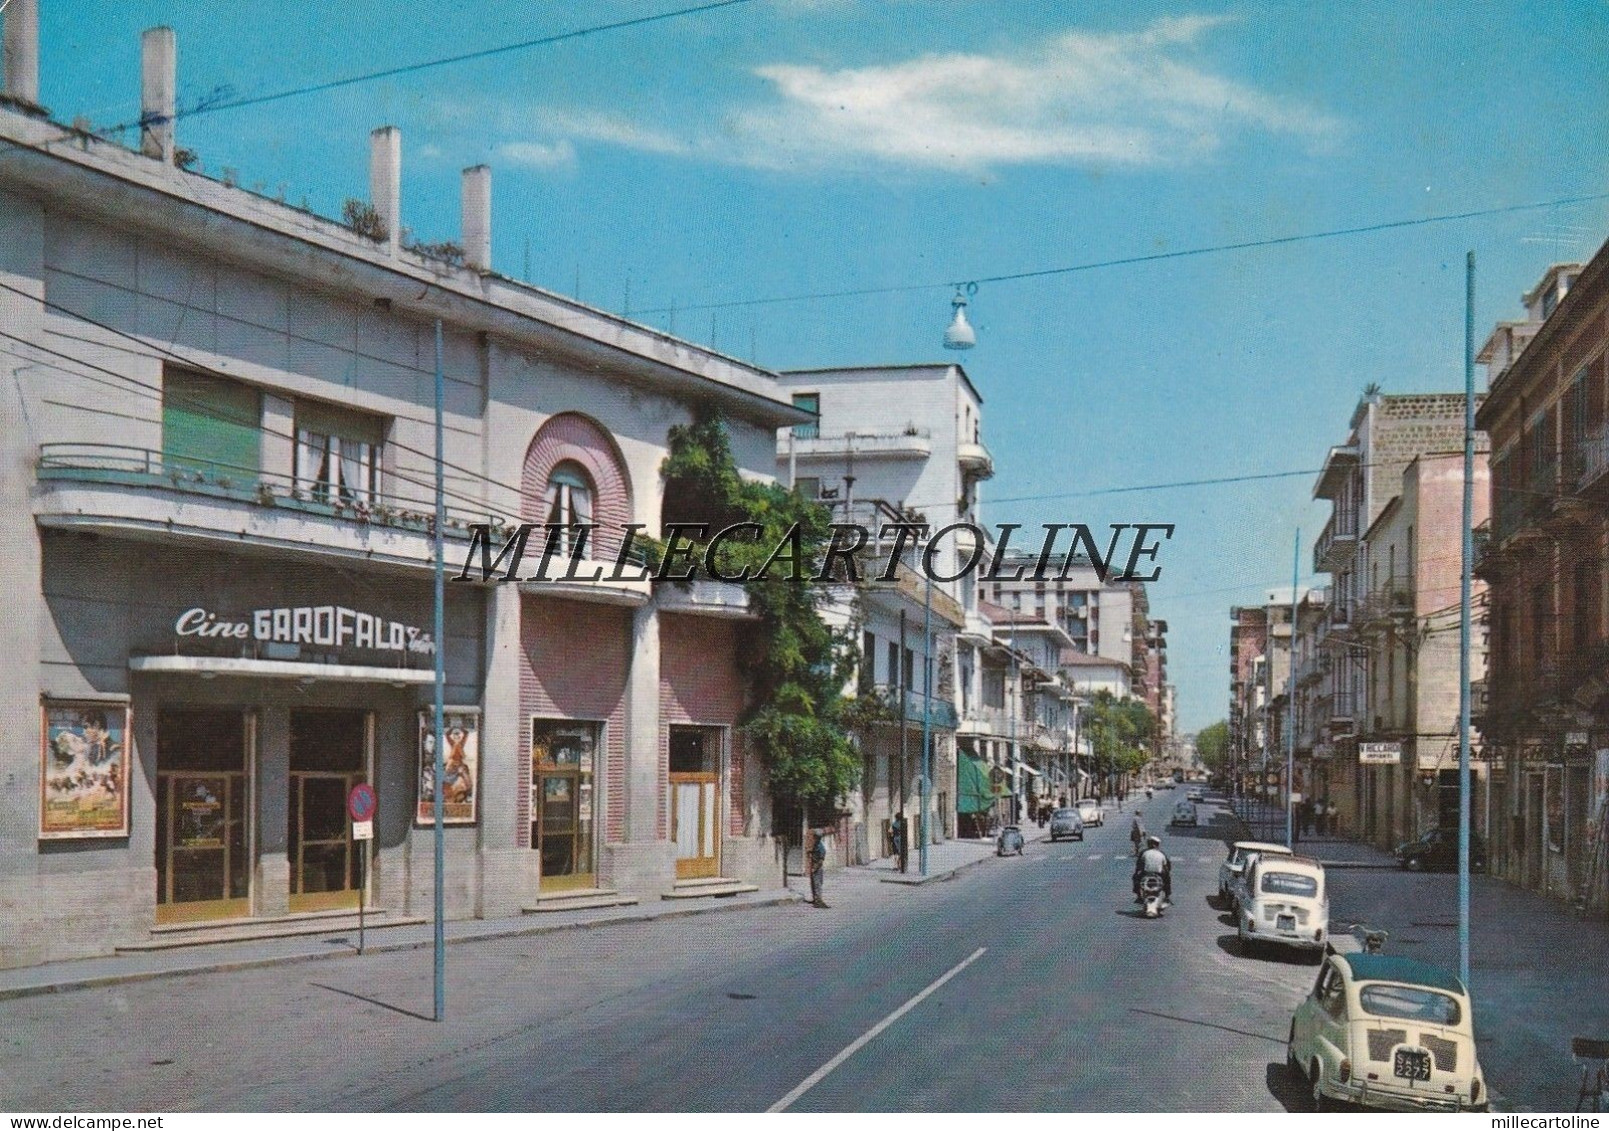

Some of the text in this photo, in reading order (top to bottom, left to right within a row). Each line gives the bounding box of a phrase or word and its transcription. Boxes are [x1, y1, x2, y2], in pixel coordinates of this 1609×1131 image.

[175, 607, 249, 639] Cine
[253, 605, 405, 651] GAROFALO
[1396, 1065, 1429, 1079] 2277
